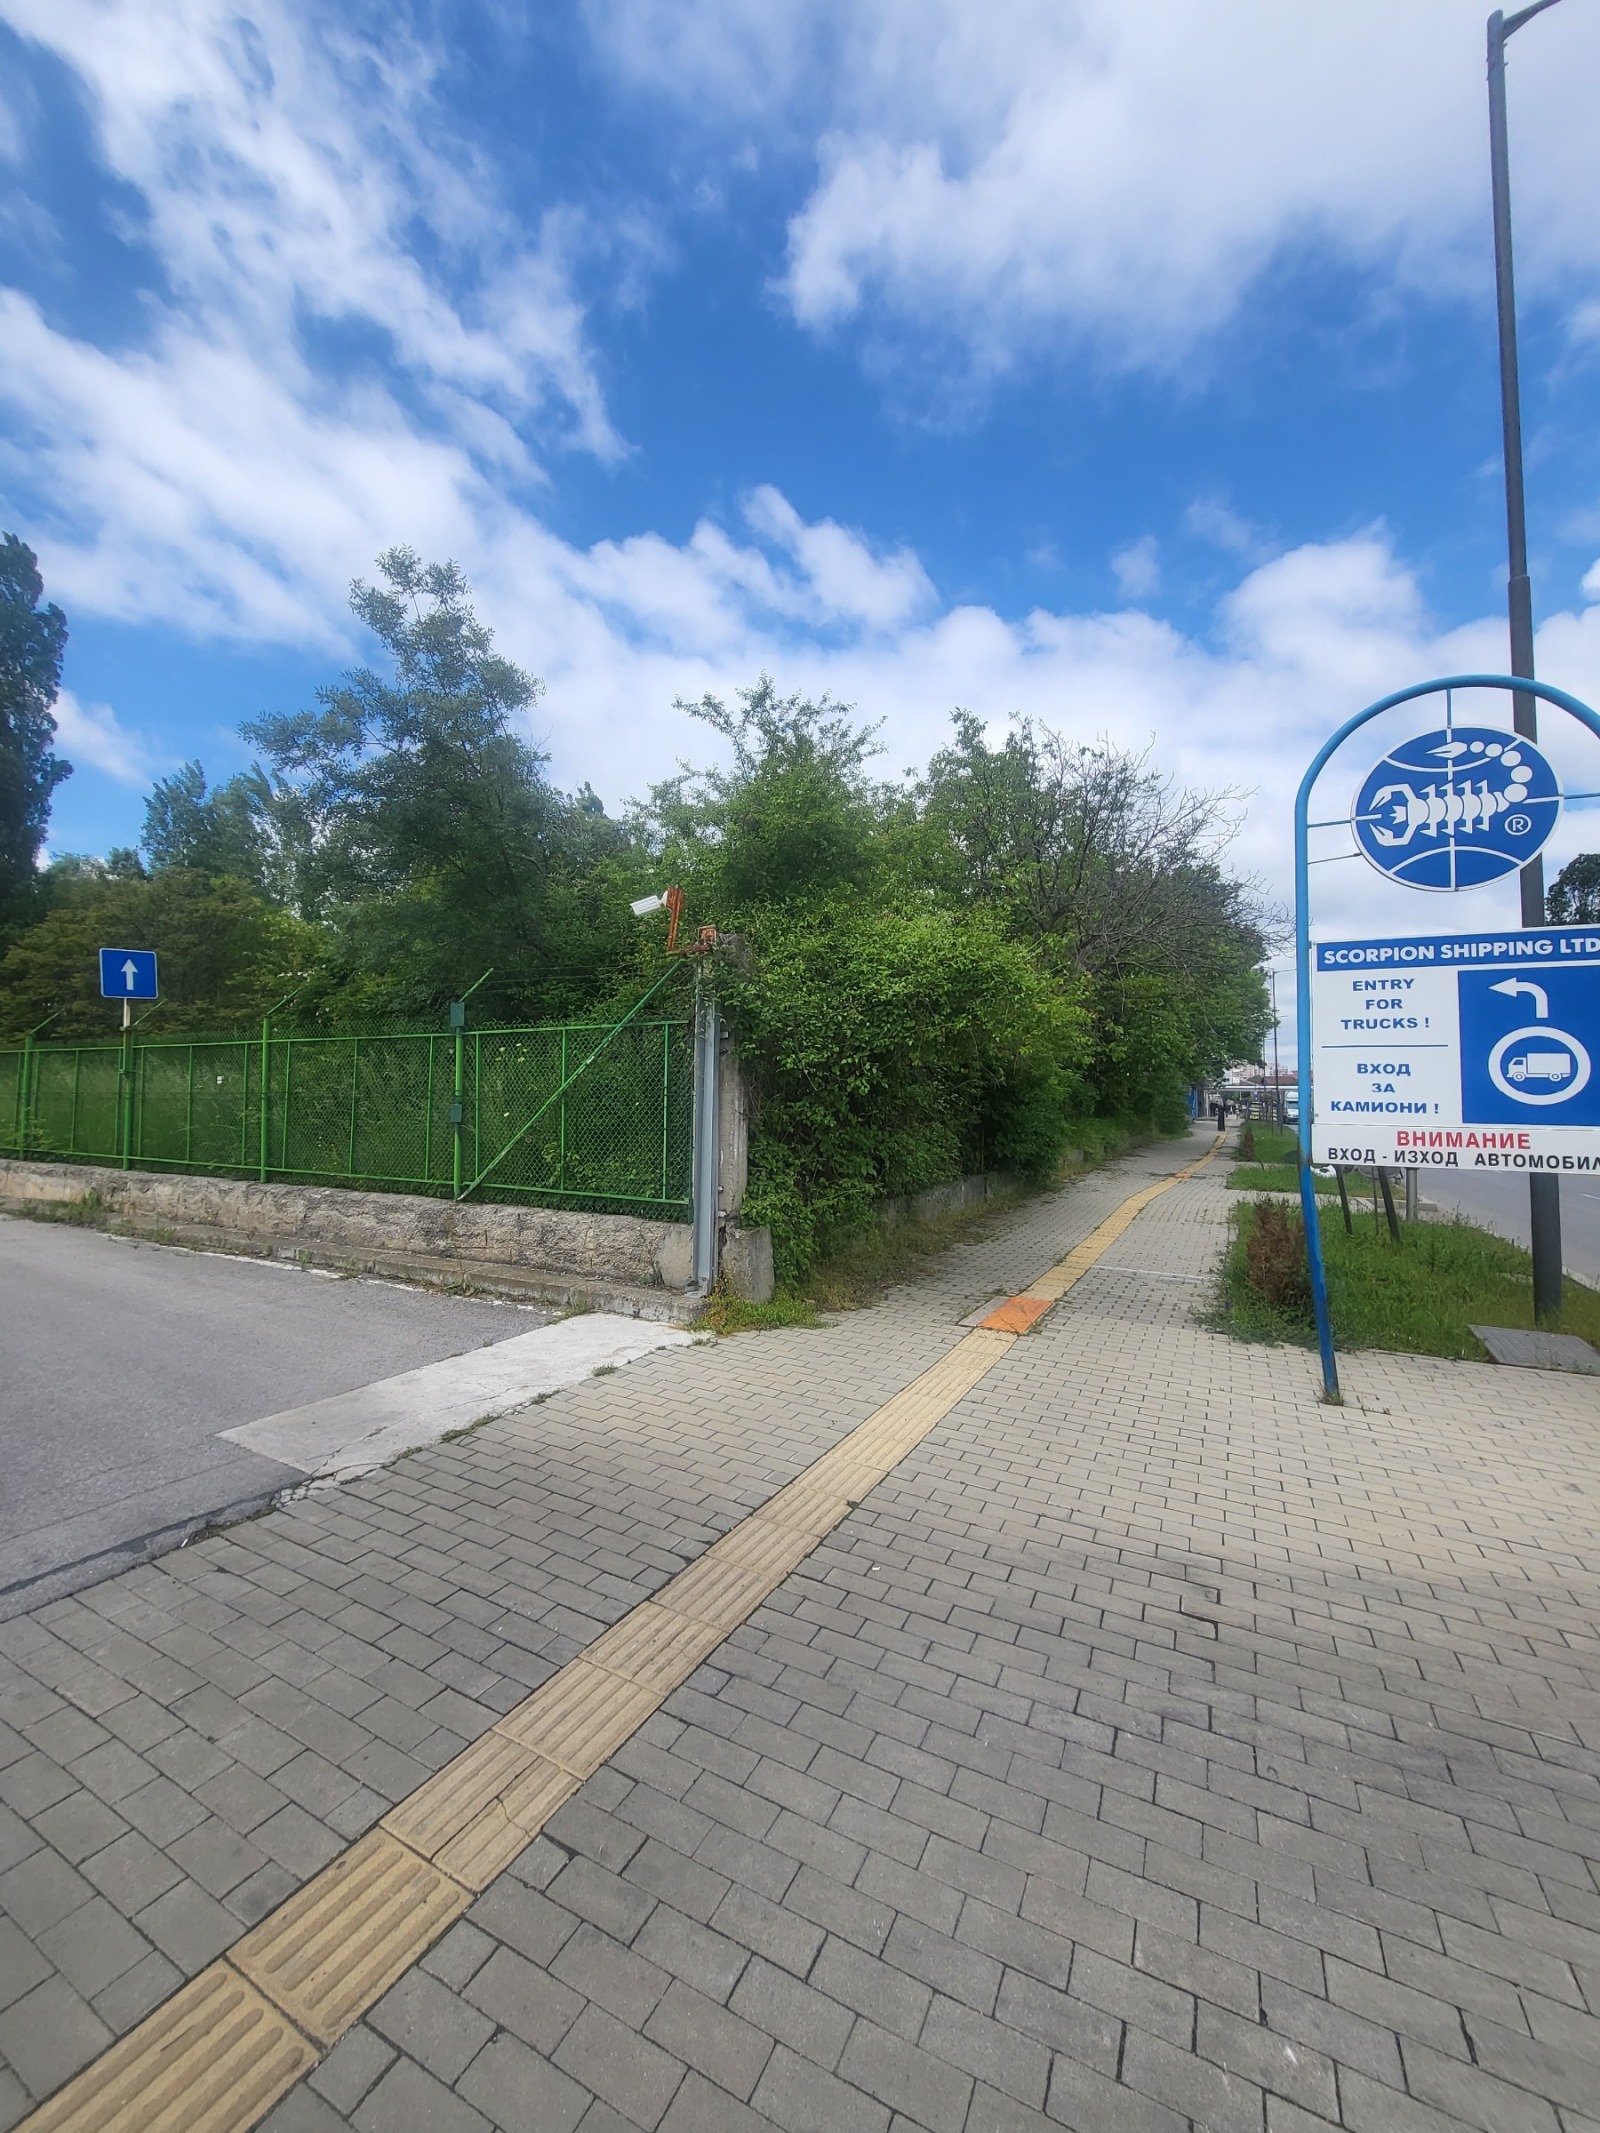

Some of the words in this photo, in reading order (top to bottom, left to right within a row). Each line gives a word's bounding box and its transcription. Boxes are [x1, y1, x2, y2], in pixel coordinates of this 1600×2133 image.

[1324, 945, 1435, 965] SCORPION
[1440, 939, 1553, 959] SHIPPING
[1560, 937, 1600, 954] LTD
[1352, 978, 1415, 991] ENTRY
[1365, 999, 1403, 1010] FOR
[1340, 1017, 1418, 1030] TRUCKS
[1356, 1063, 1411, 1076] ВХОД
[1371, 1083, 1396, 1093] ЗА
[1330, 1101, 1427, 1114] КАМИОНИ
[1396, 1130, 1531, 1150] ВНИМАНИЕ
[1328, 1147, 1376, 1164] ВХОД
[1394, 1150, 1458, 1168] ИЗХОД
